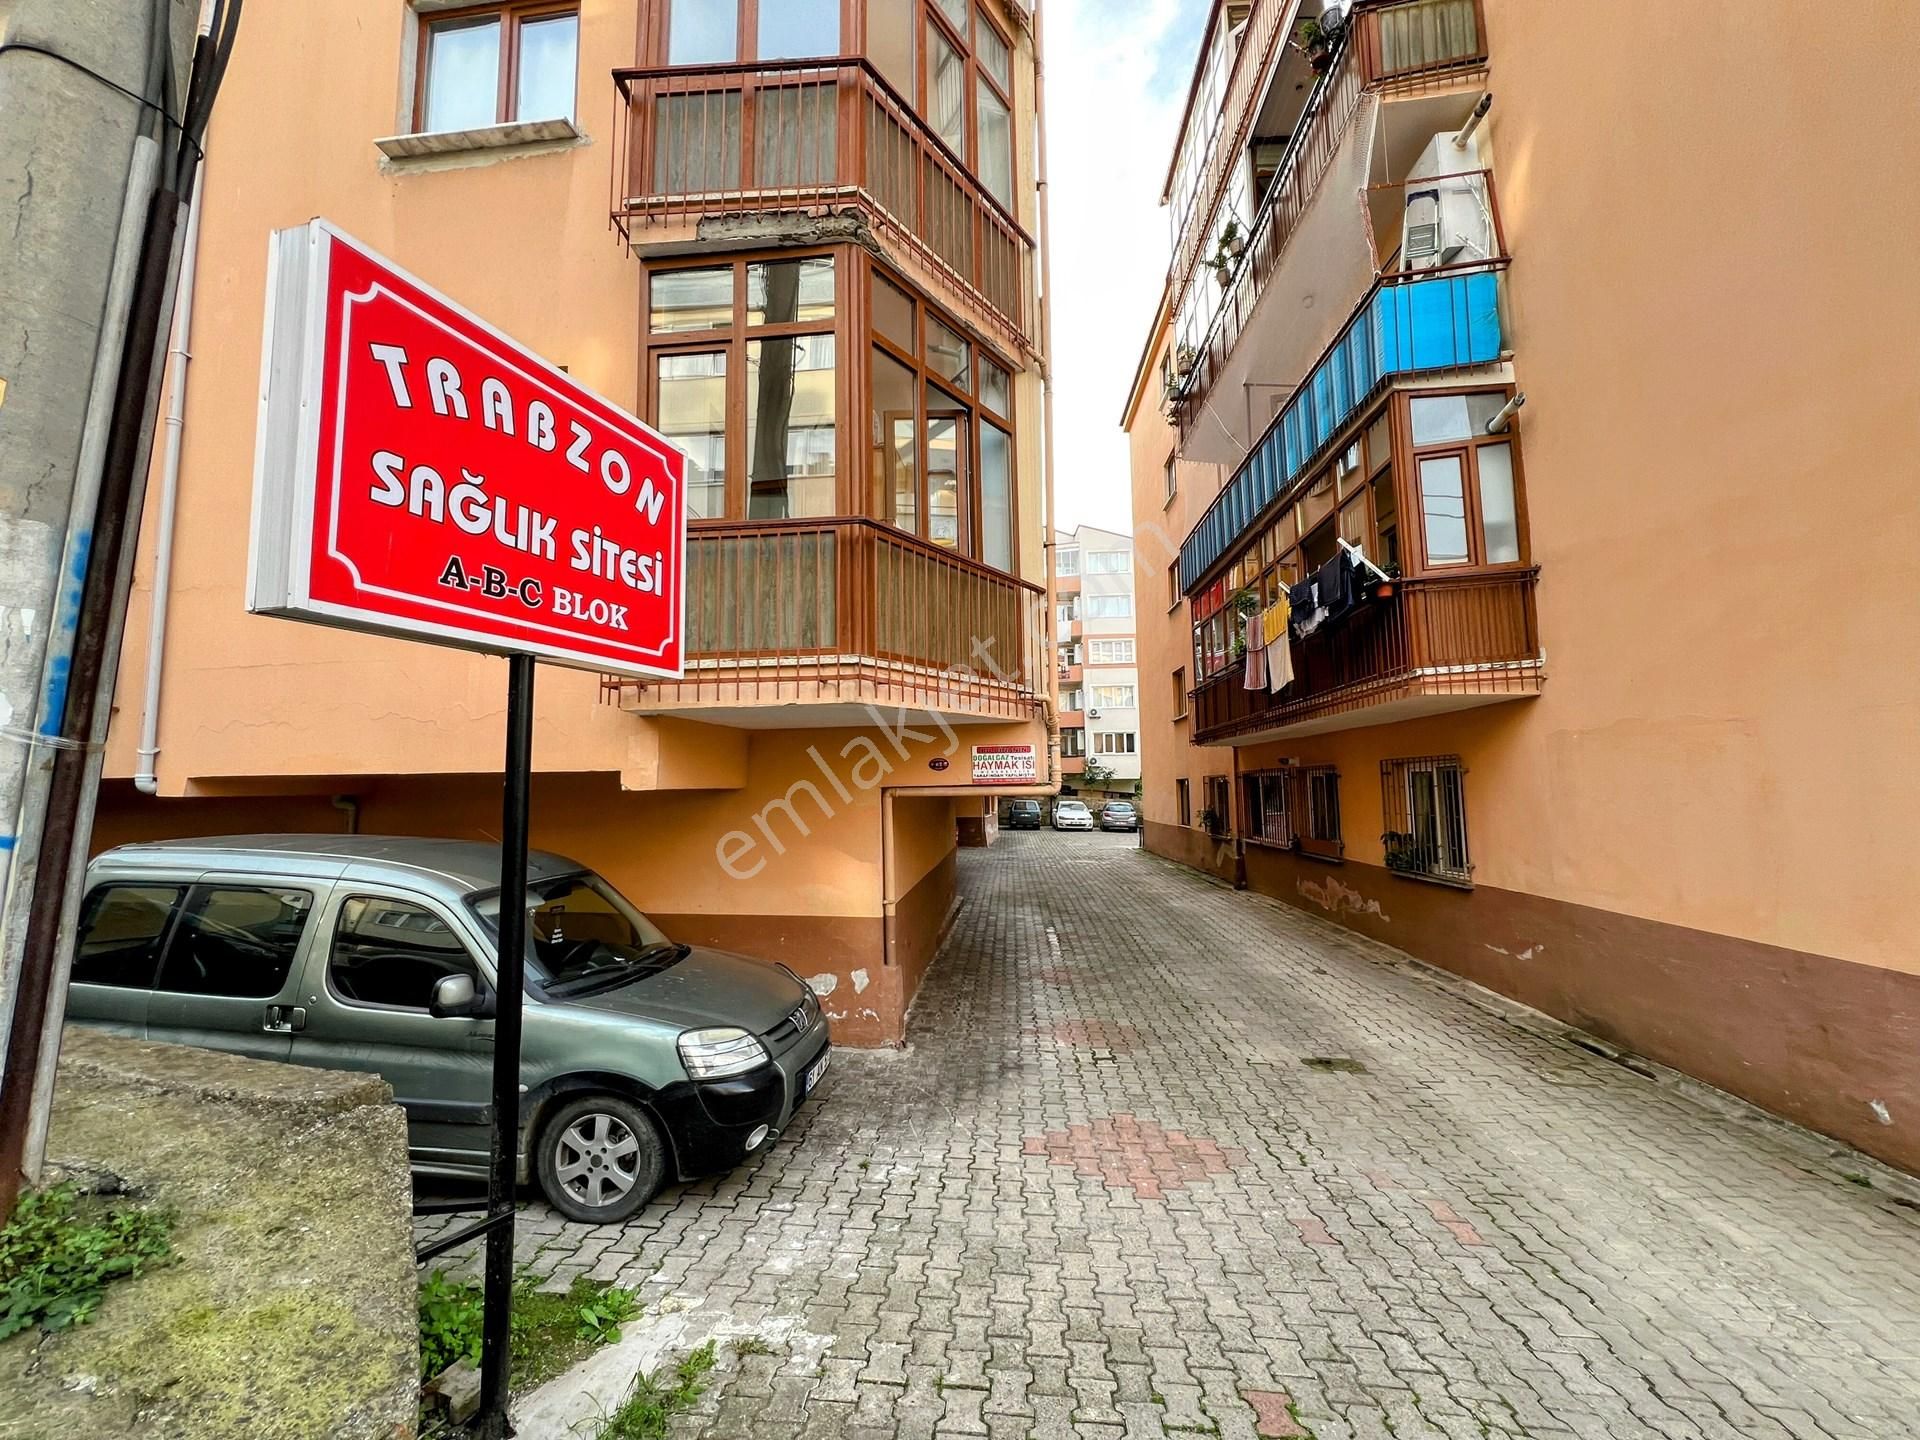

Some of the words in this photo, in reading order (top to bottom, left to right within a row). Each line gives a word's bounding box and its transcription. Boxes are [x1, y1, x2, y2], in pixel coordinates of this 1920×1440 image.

[369, 342, 665, 526] TRABZON
[369, 450, 557, 561] SAĞLIK
[570, 525, 663, 597] SİTESİ
[439, 555, 543, 608] A-B-C
[551, 586, 630, 632] BLOK
[973, 760, 1018, 770] HAYMAK
